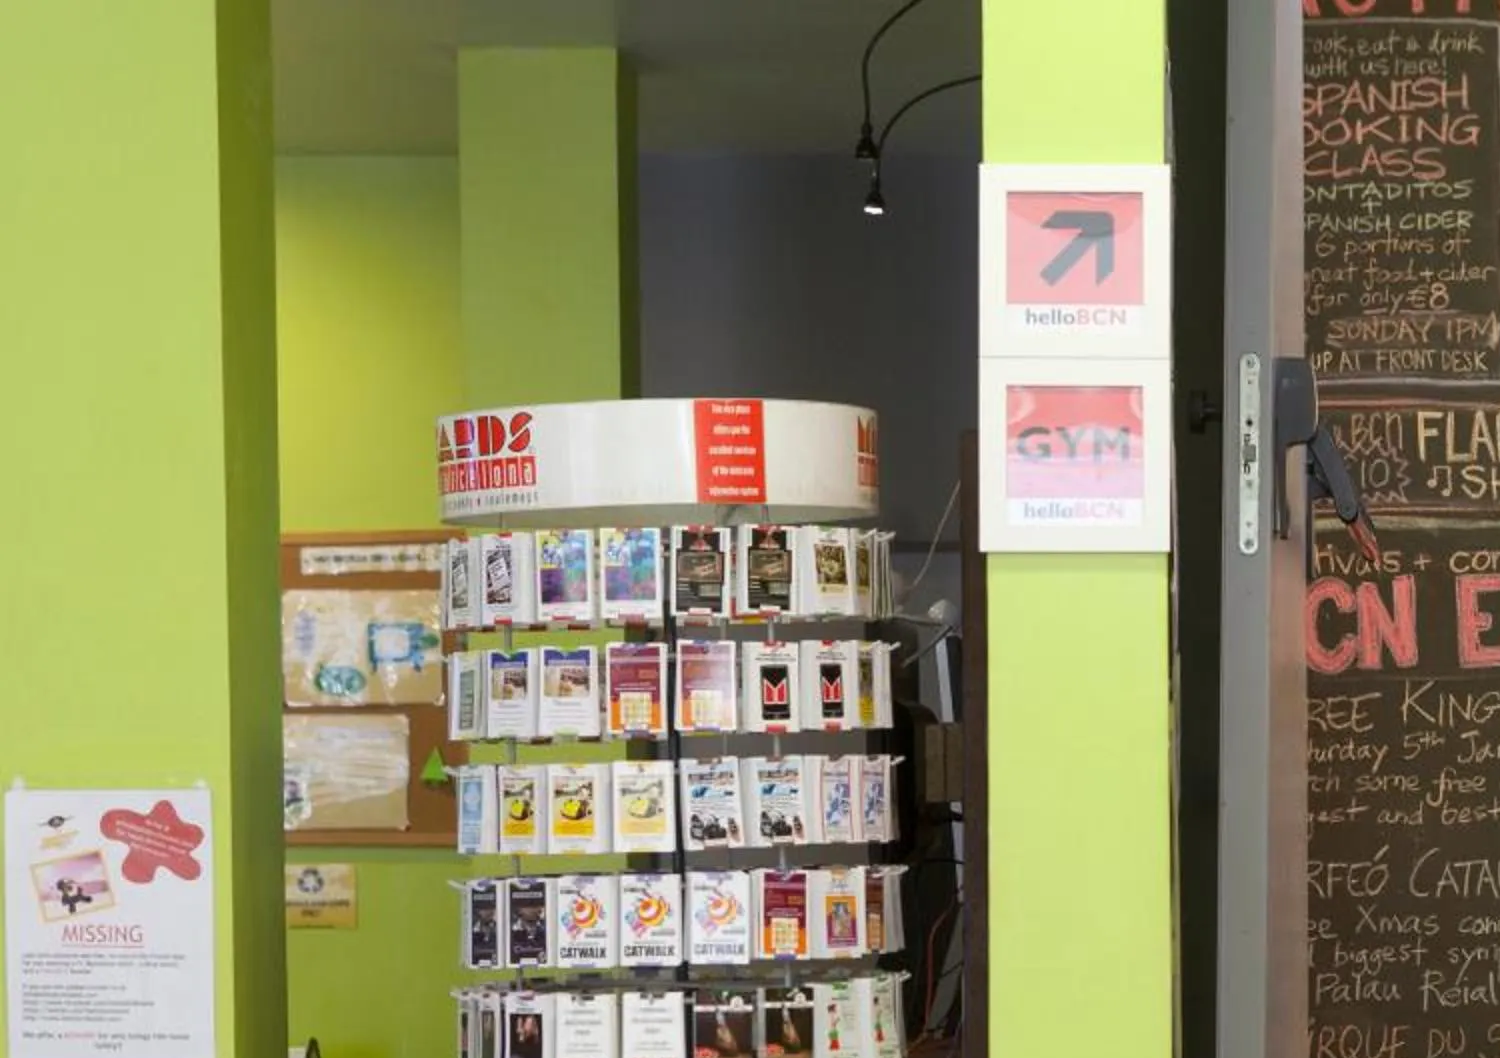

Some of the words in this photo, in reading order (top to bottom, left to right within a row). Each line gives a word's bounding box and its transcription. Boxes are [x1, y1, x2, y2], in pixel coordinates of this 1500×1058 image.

[1428, 29, 1484, 55] drink
[1305, 54, 1348, 78] with
[1360, 58, 1389, 76] us
[1303, 72, 1470, 117] SPANISH
[1303, 112, 1481, 147] OOKING
[1303, 144, 1447, 180] CLASS
[1303, 179, 1475, 202] ONTADITOS
[1303, 213, 1391, 233] PANISH
[1400, 210, 1474, 230] CIDER
[1315, 232, 1336, 257] 6
[1442, 228, 1472, 257] of
[1363, 258, 1418, 291] food
[1437, 262, 1496, 282] cider
[1307, 284, 1349, 316] for
[1360, 288, 1406, 316] only
[1024, 308, 1127, 326] helloBCN
[1327, 317, 1436, 344] SUNDAY
[1311, 351, 1333, 373] UP
[1339, 351, 1361, 373] AT
[1376, 350, 1436, 373] FRONT
[1441, 351, 1489, 373] DESK
[1016, 426, 1130, 463] GYM
[1023, 501, 1125, 519] helloBCN
[1306, 574, 1419, 675] CN
[1308, 692, 1382, 733] REE
[1308, 737, 1389, 774] turday
[1403, 731, 1445, 760] 5th
[1356, 774, 1421, 793] some
[1426, 767, 1487, 807] free
[1377, 800, 1425, 825] and
[1307, 844, 1390, 898] RFEÓ
[62, 924, 144, 943] MISSING
[1355, 904, 1440, 935] Xmas
[1333, 936, 1428, 976] biggest
[1316, 972, 1401, 1004] Palau
